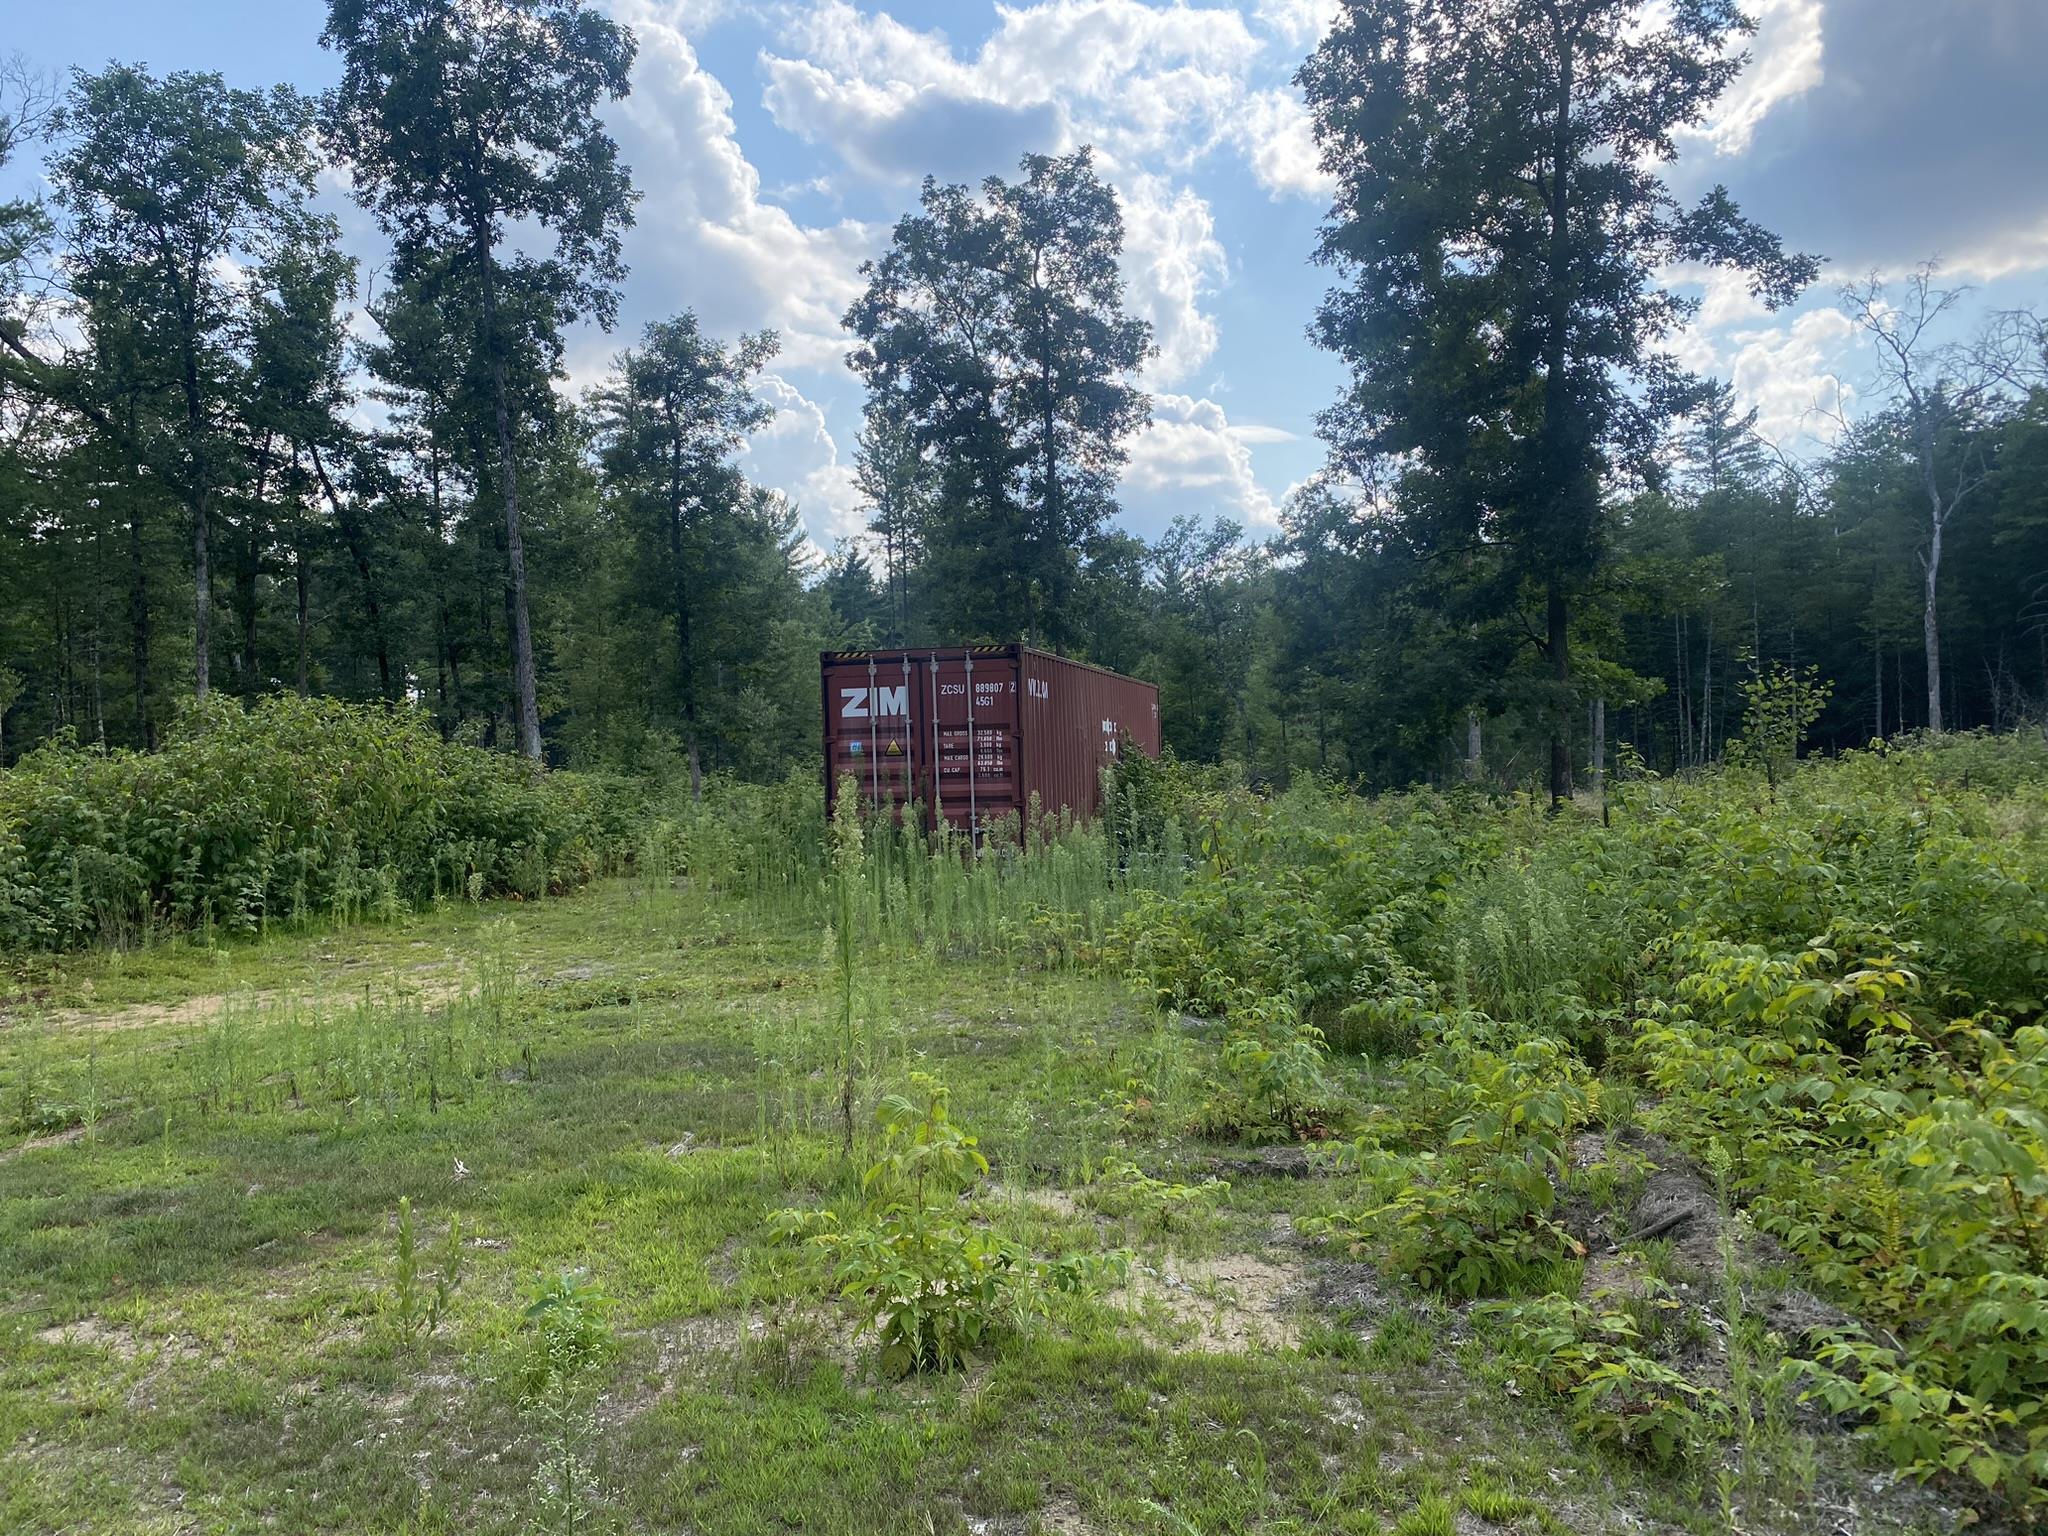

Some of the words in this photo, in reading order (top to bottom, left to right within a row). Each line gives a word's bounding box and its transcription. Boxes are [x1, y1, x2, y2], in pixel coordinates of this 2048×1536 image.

[941, 684, 964, 695] ZCSU
[975, 682, 1003, 693] 889807
[1010, 682, 1016, 693] 2
[841, 686, 907, 717] ZIM
[975, 695, 993, 706] 45G1
